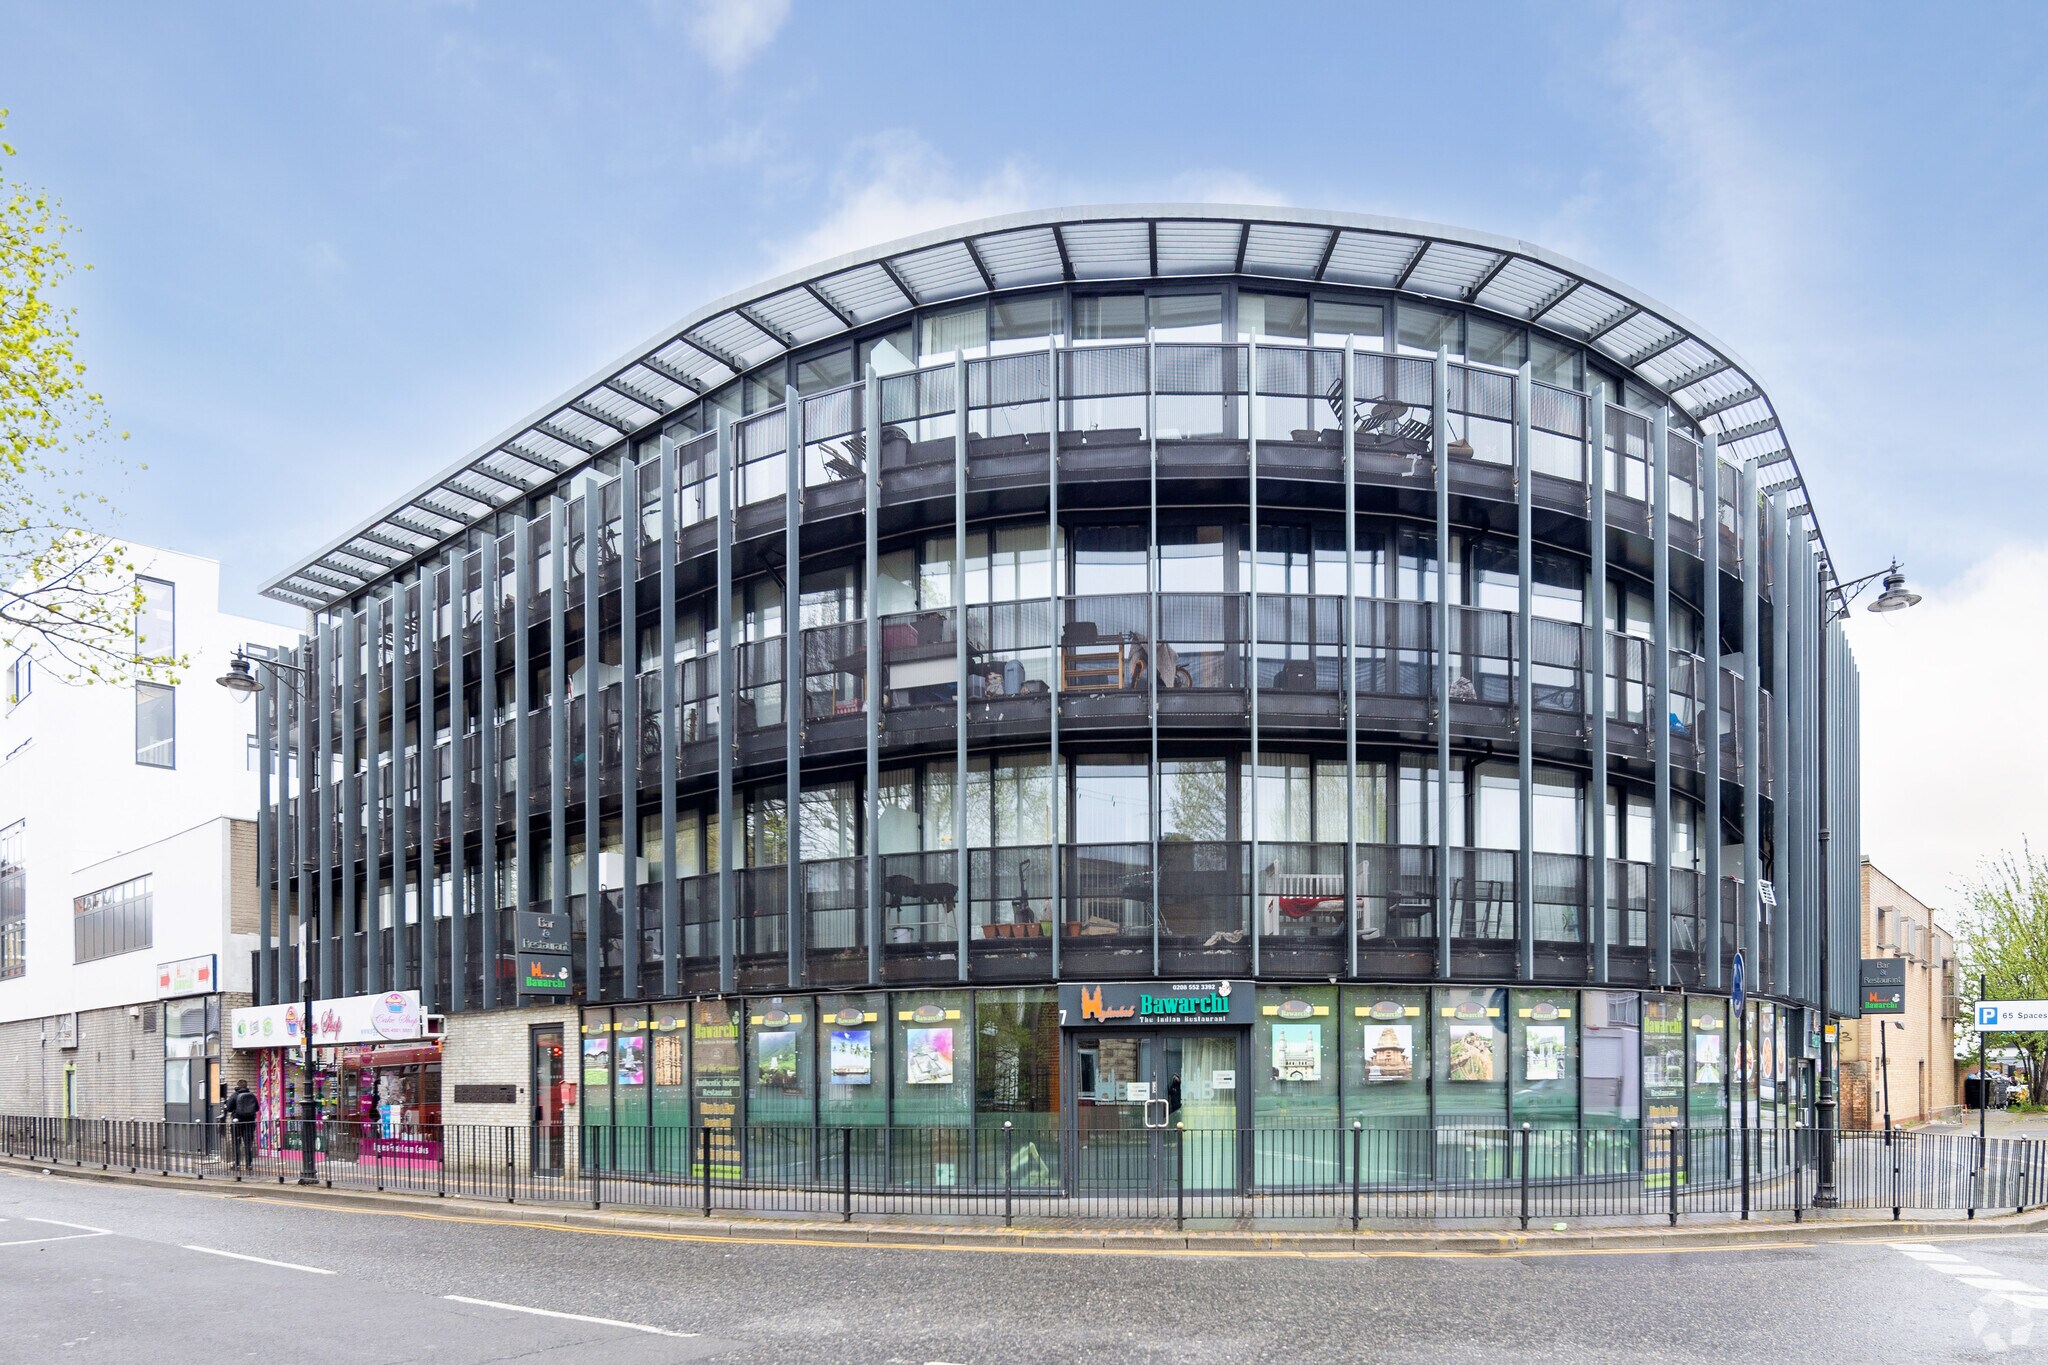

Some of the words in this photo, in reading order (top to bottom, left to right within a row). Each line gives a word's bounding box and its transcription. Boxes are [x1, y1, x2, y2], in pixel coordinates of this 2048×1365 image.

[538, 916, 555, 928] Bar
[1876, 961, 1890, 969] Bar
[525, 976, 566, 988] Bawarchi
[1863, 976, 1902, 984] Restaurant
[1140, 992, 1230, 1015] Bawarchi
[1864, 1001, 1898, 1009] Bawarchi
[1059, 1010, 1067, 1025] 7
[1184, 1015, 1226, 1023] Restaurant
[1982, 1008, 1996, 1024] P
[694, 1021, 739, 1039] Bawarchi
[1643, 1016, 1682, 1034] Bawarchi
[696, 1079, 721, 1087] Authentic
[722, 1078, 741, 1087] Indian
[702, 1088, 733, 1097] Restaurant
